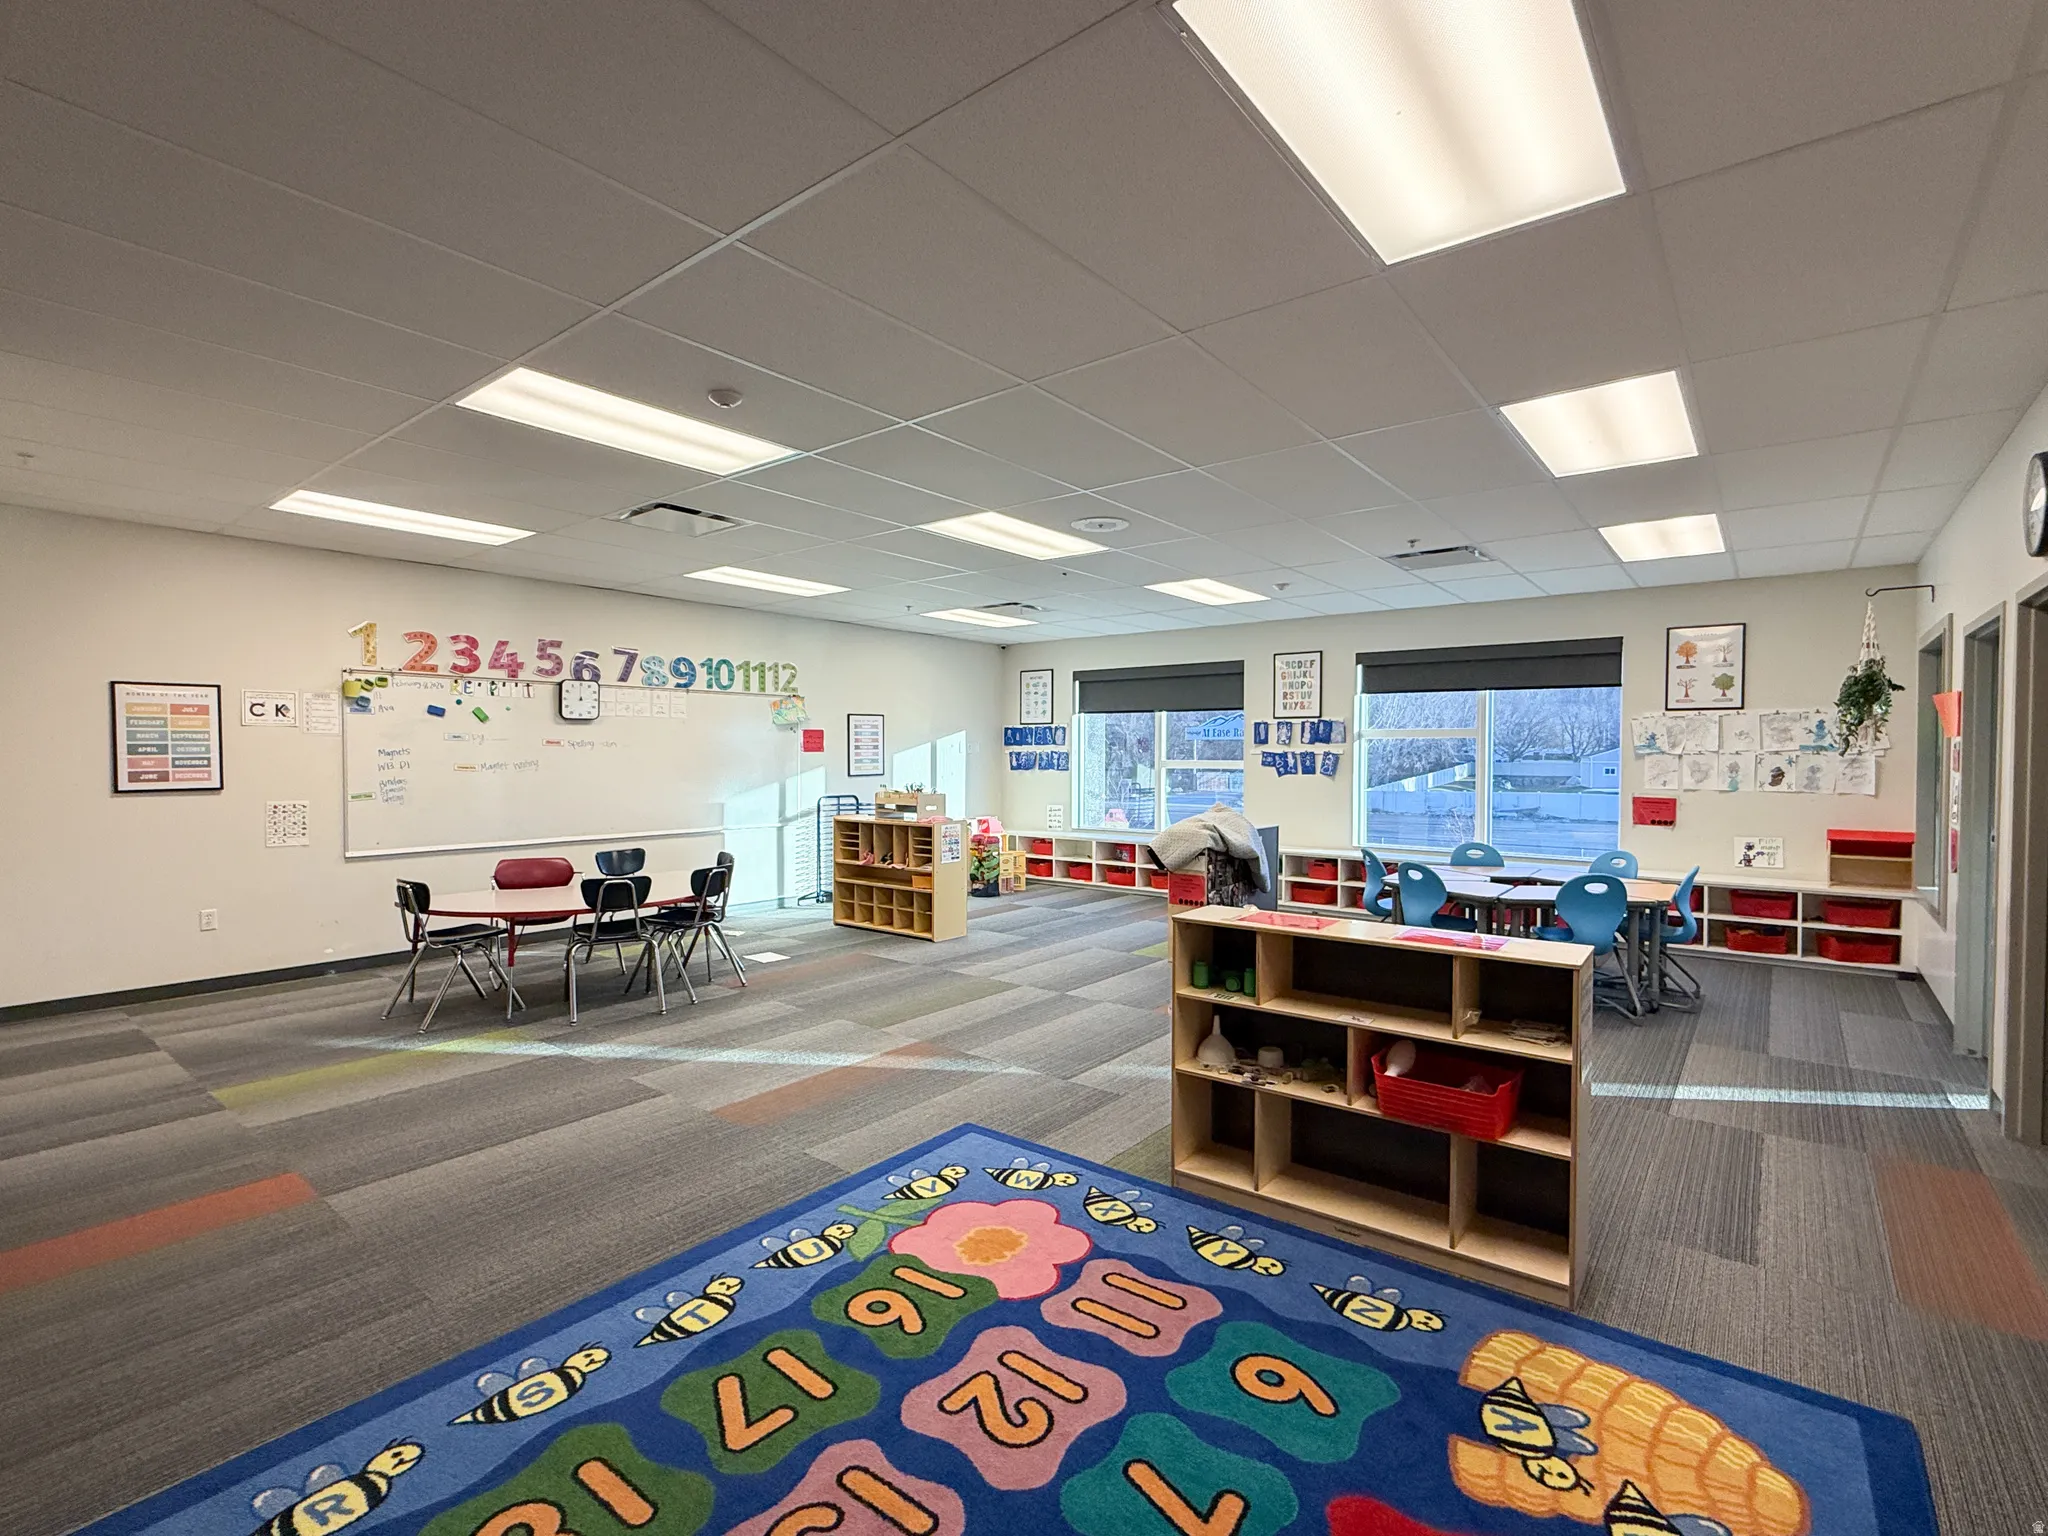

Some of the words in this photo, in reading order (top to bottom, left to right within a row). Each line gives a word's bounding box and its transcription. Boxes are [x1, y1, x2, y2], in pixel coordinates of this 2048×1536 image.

[347, 621, 377, 666] 1
[401, 630, 439, 673] 2
[448, 634, 481, 675] 3
[487, 640, 525, 679] 4
[533, 638, 563, 678] 5
[571, 650, 602, 682] 6
[611, 645, 640, 683] 7
[641, 655, 669, 687] 8
[670, 656, 697, 689] 9
[699, 657, 736, 691] 10
[736, 660, 766, 693] 11
[767, 661, 799, 694] 12
[249, 703, 265, 717] C
[275, 704, 287, 717] K
[1212, 728, 1230, 737] Ease
[916, 1180, 936, 1192] V
[1014, 1172, 1041, 1186] W
[1094, 1204, 1124, 1216] X
[795, 1242, 821, 1258] U
[1212, 1242, 1240, 1256] Y
[843, 1264, 969, 1334] 16
[1071, 1270, 1188, 1339] 11
[1350, 1298, 1387, 1322] Z
[676, 1303, 711, 1326] T
[516, 1380, 554, 1406] S
[711, 1346, 837, 1454] 17
[936, 1349, 1089, 1448] 12
[1490, 1407, 1540, 1434] A
[303, 1493, 356, 1527] R
